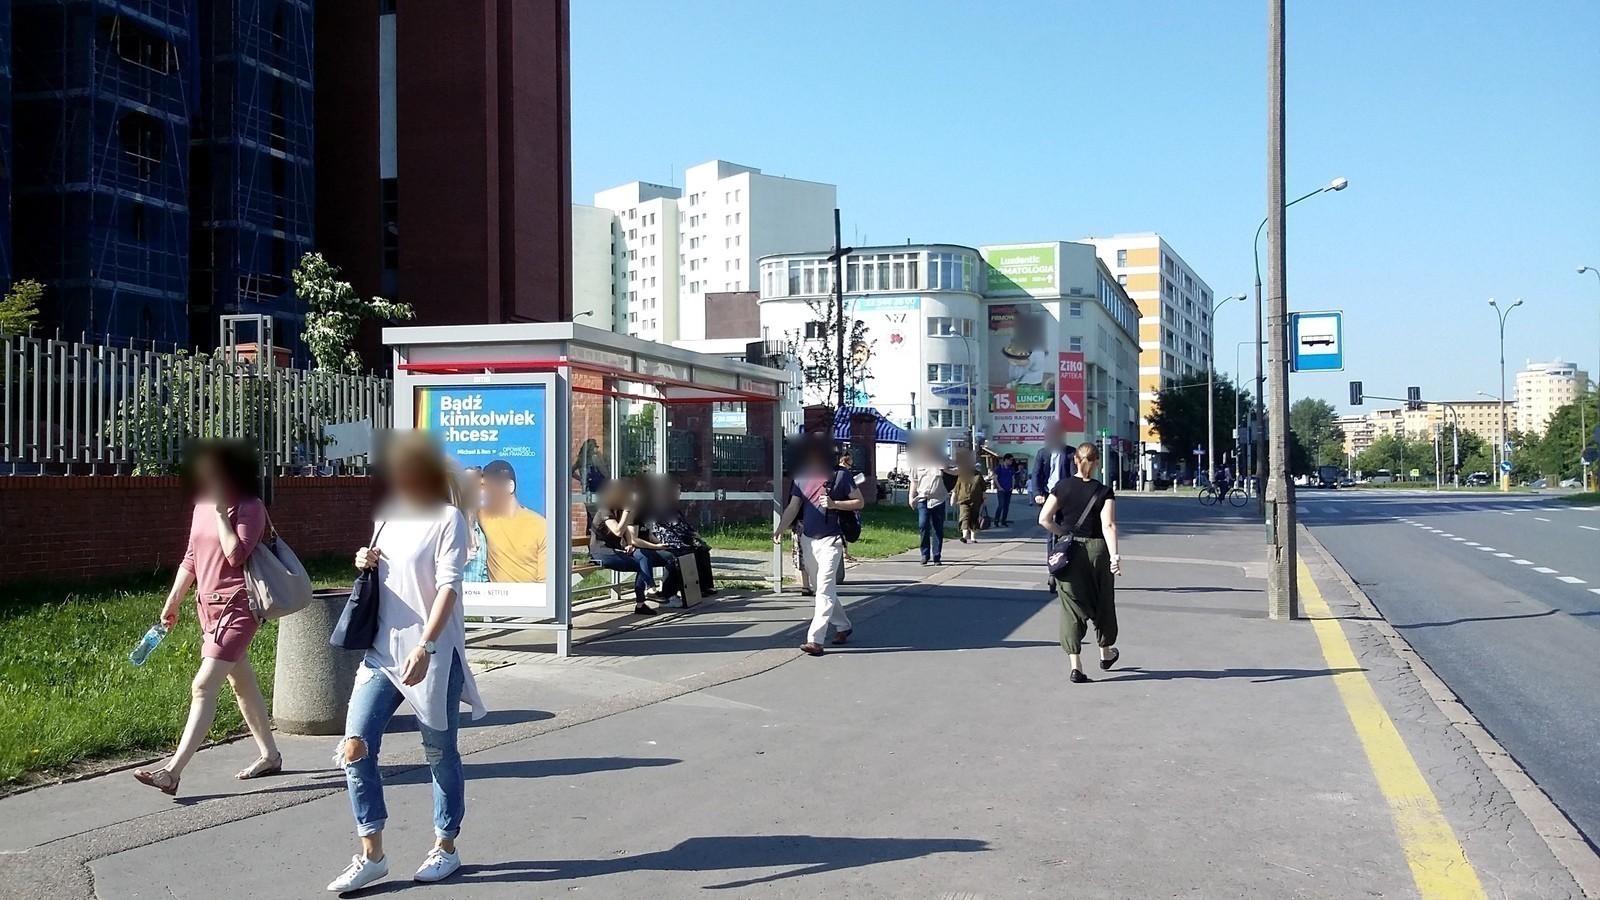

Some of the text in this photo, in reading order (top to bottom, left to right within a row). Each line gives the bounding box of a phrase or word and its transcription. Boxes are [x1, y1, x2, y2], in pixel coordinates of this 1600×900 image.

[440, 394, 483, 414] Bądź
[993, 393, 1010, 409] 15
[440, 410, 536, 426] kimkolwiek
